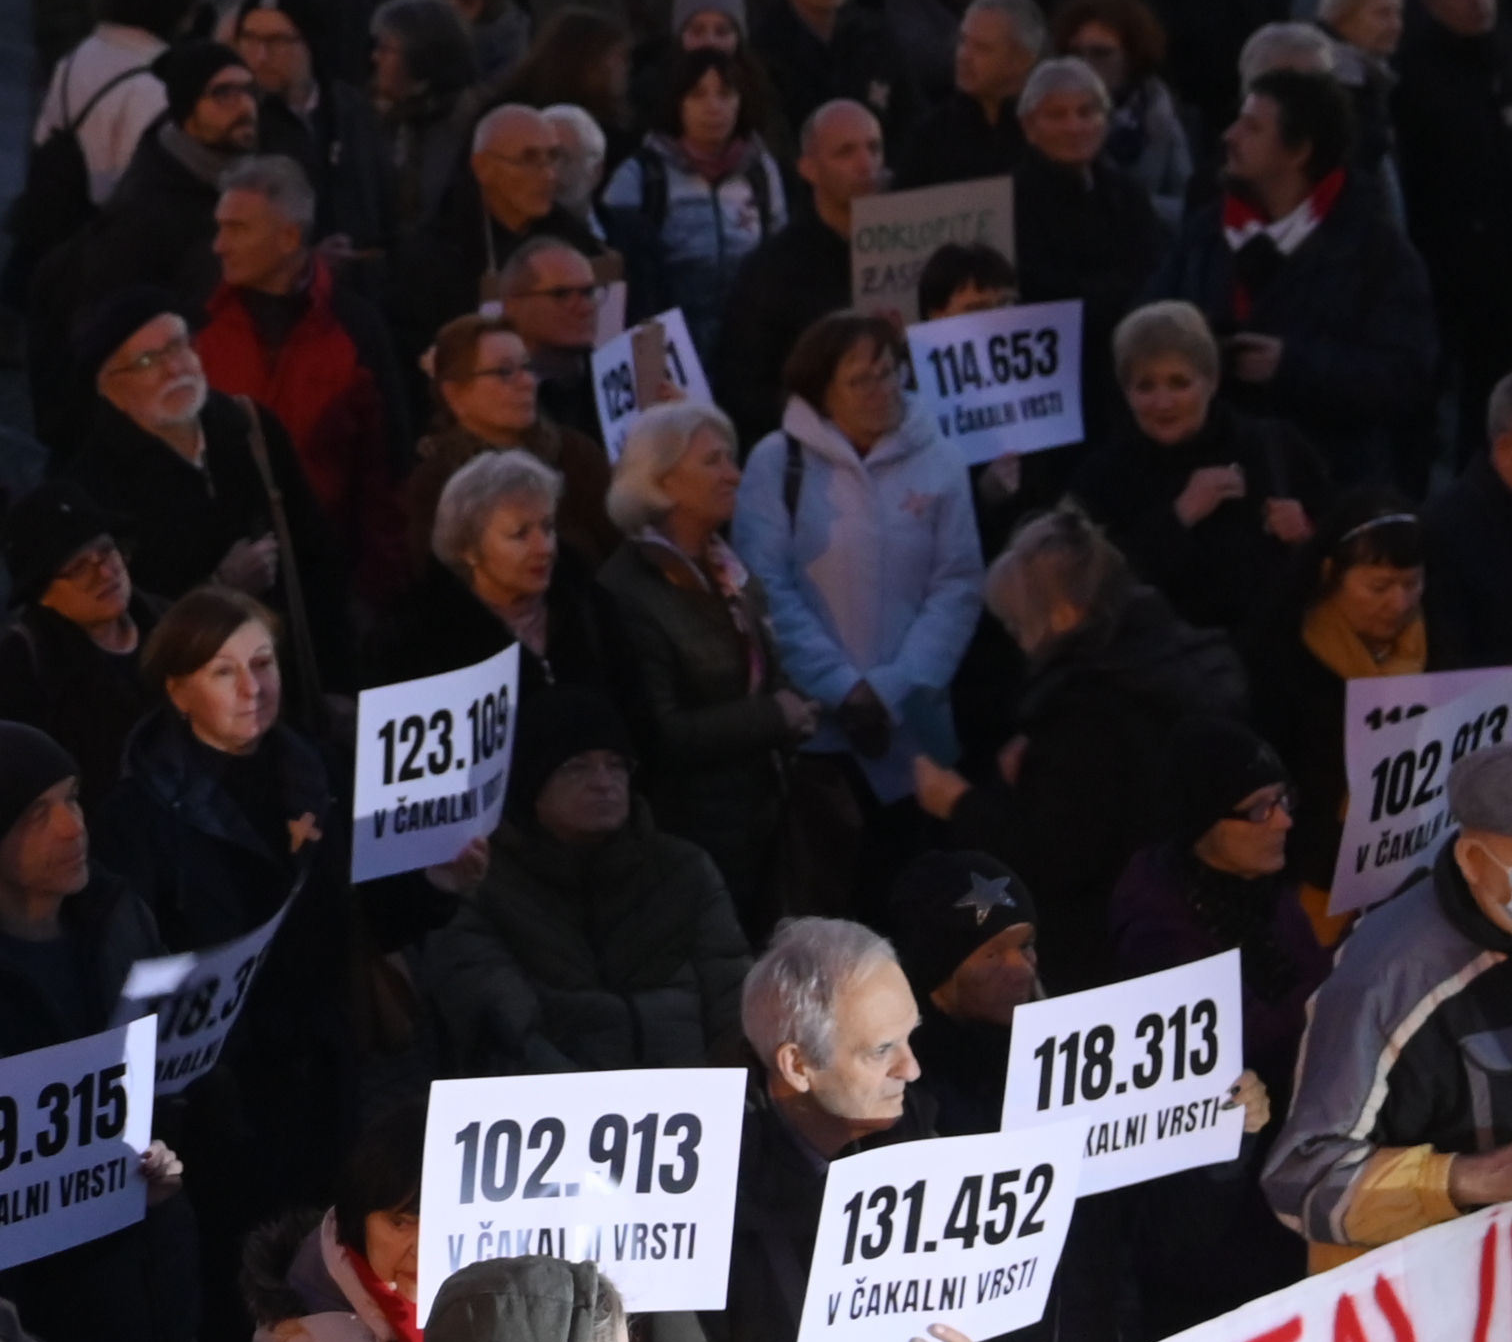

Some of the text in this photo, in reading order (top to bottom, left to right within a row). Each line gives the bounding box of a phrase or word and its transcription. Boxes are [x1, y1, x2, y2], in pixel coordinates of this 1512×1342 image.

[926, 327, 1060, 399] 114.653
[377, 684, 509, 787] 123.109
[373, 807, 388, 840] V
[392, 787, 479, 835] ČAKALNI
[1354, 843, 1370, 875] V
[1033, 997, 1219, 1113] 118.313
[453, 1111, 703, 1206] 102.913
[1082, 1095, 1221, 1159] KALNI VRSTI
[59, 1156, 127, 1208] VRSTI
[841, 1162, 1055, 1267] 131.452
[447, 1232, 465, 1273] V
[612, 1221, 698, 1263] VRSTI
[826, 1256, 1039, 1327] V ČAKALNI VRSTI
